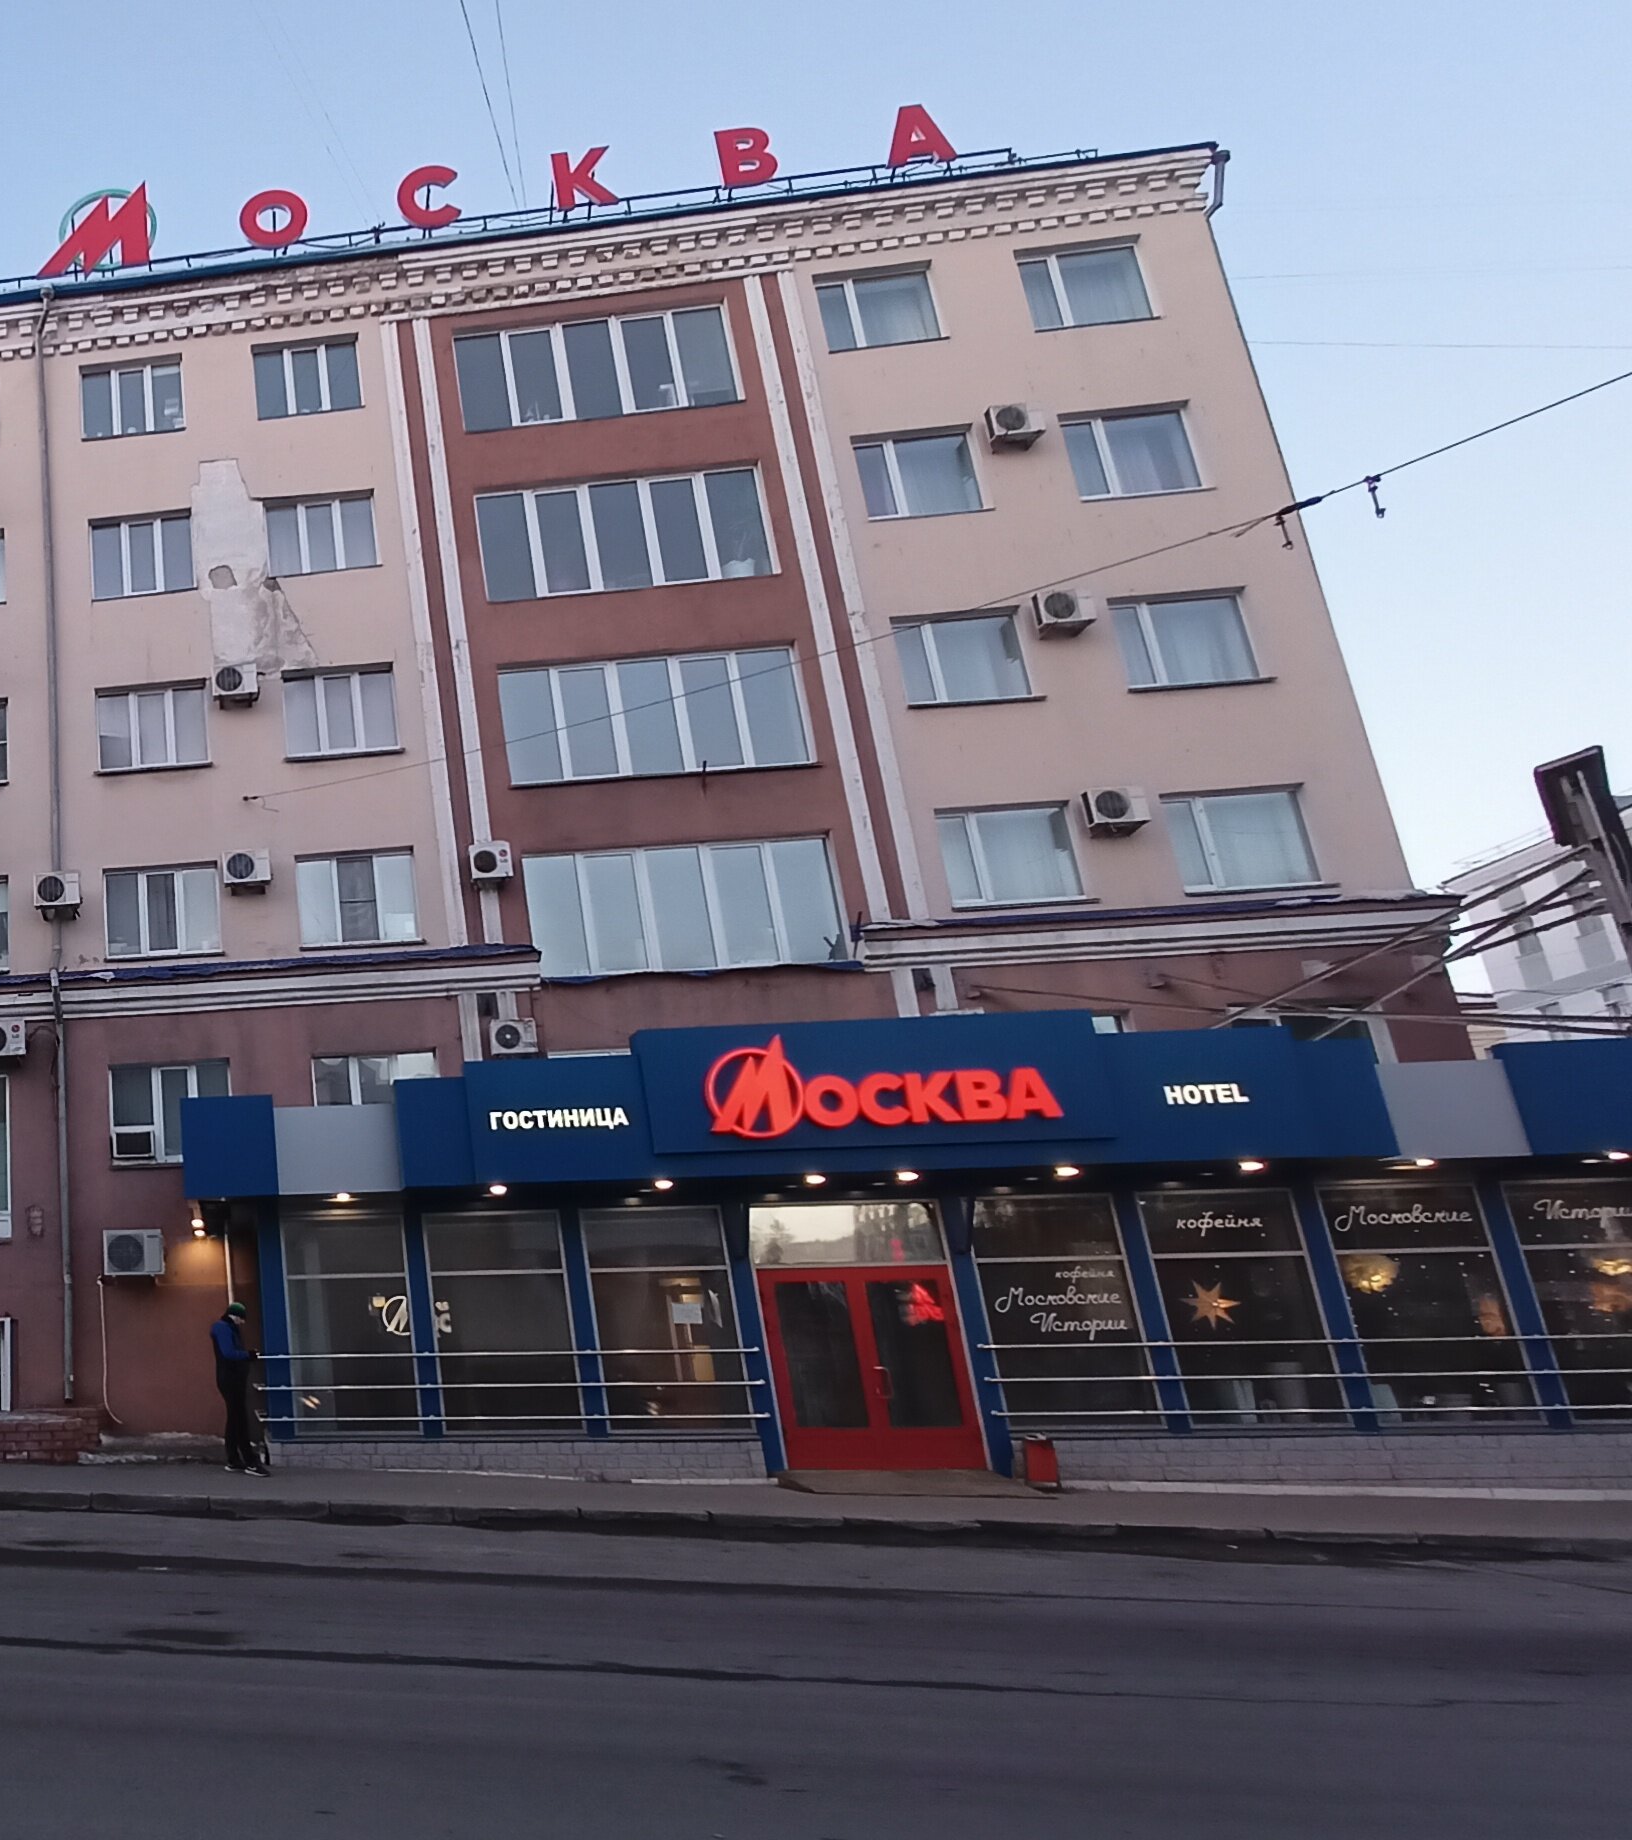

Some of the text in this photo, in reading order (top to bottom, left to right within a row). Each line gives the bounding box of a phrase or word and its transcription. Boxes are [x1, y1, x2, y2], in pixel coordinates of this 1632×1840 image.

[36, 104, 959, 279] МОСКВА
[705, 1034, 1064, 1138] МОСКВА
[1164, 1082, 1250, 1107] HOTEL
[489, 1105, 630, 1132] ГОСТИНИЦА
[1176, 1211, 1263, 1237] кофейня
[1334, 1204, 1473, 1232] Московские
[1533, 1198, 1632, 1228] Истори
[1055, 1266, 1115, 1283] кофейня
[994, 1285, 1121, 1313] Московские
[1029, 1312, 1128, 1341] Истории
